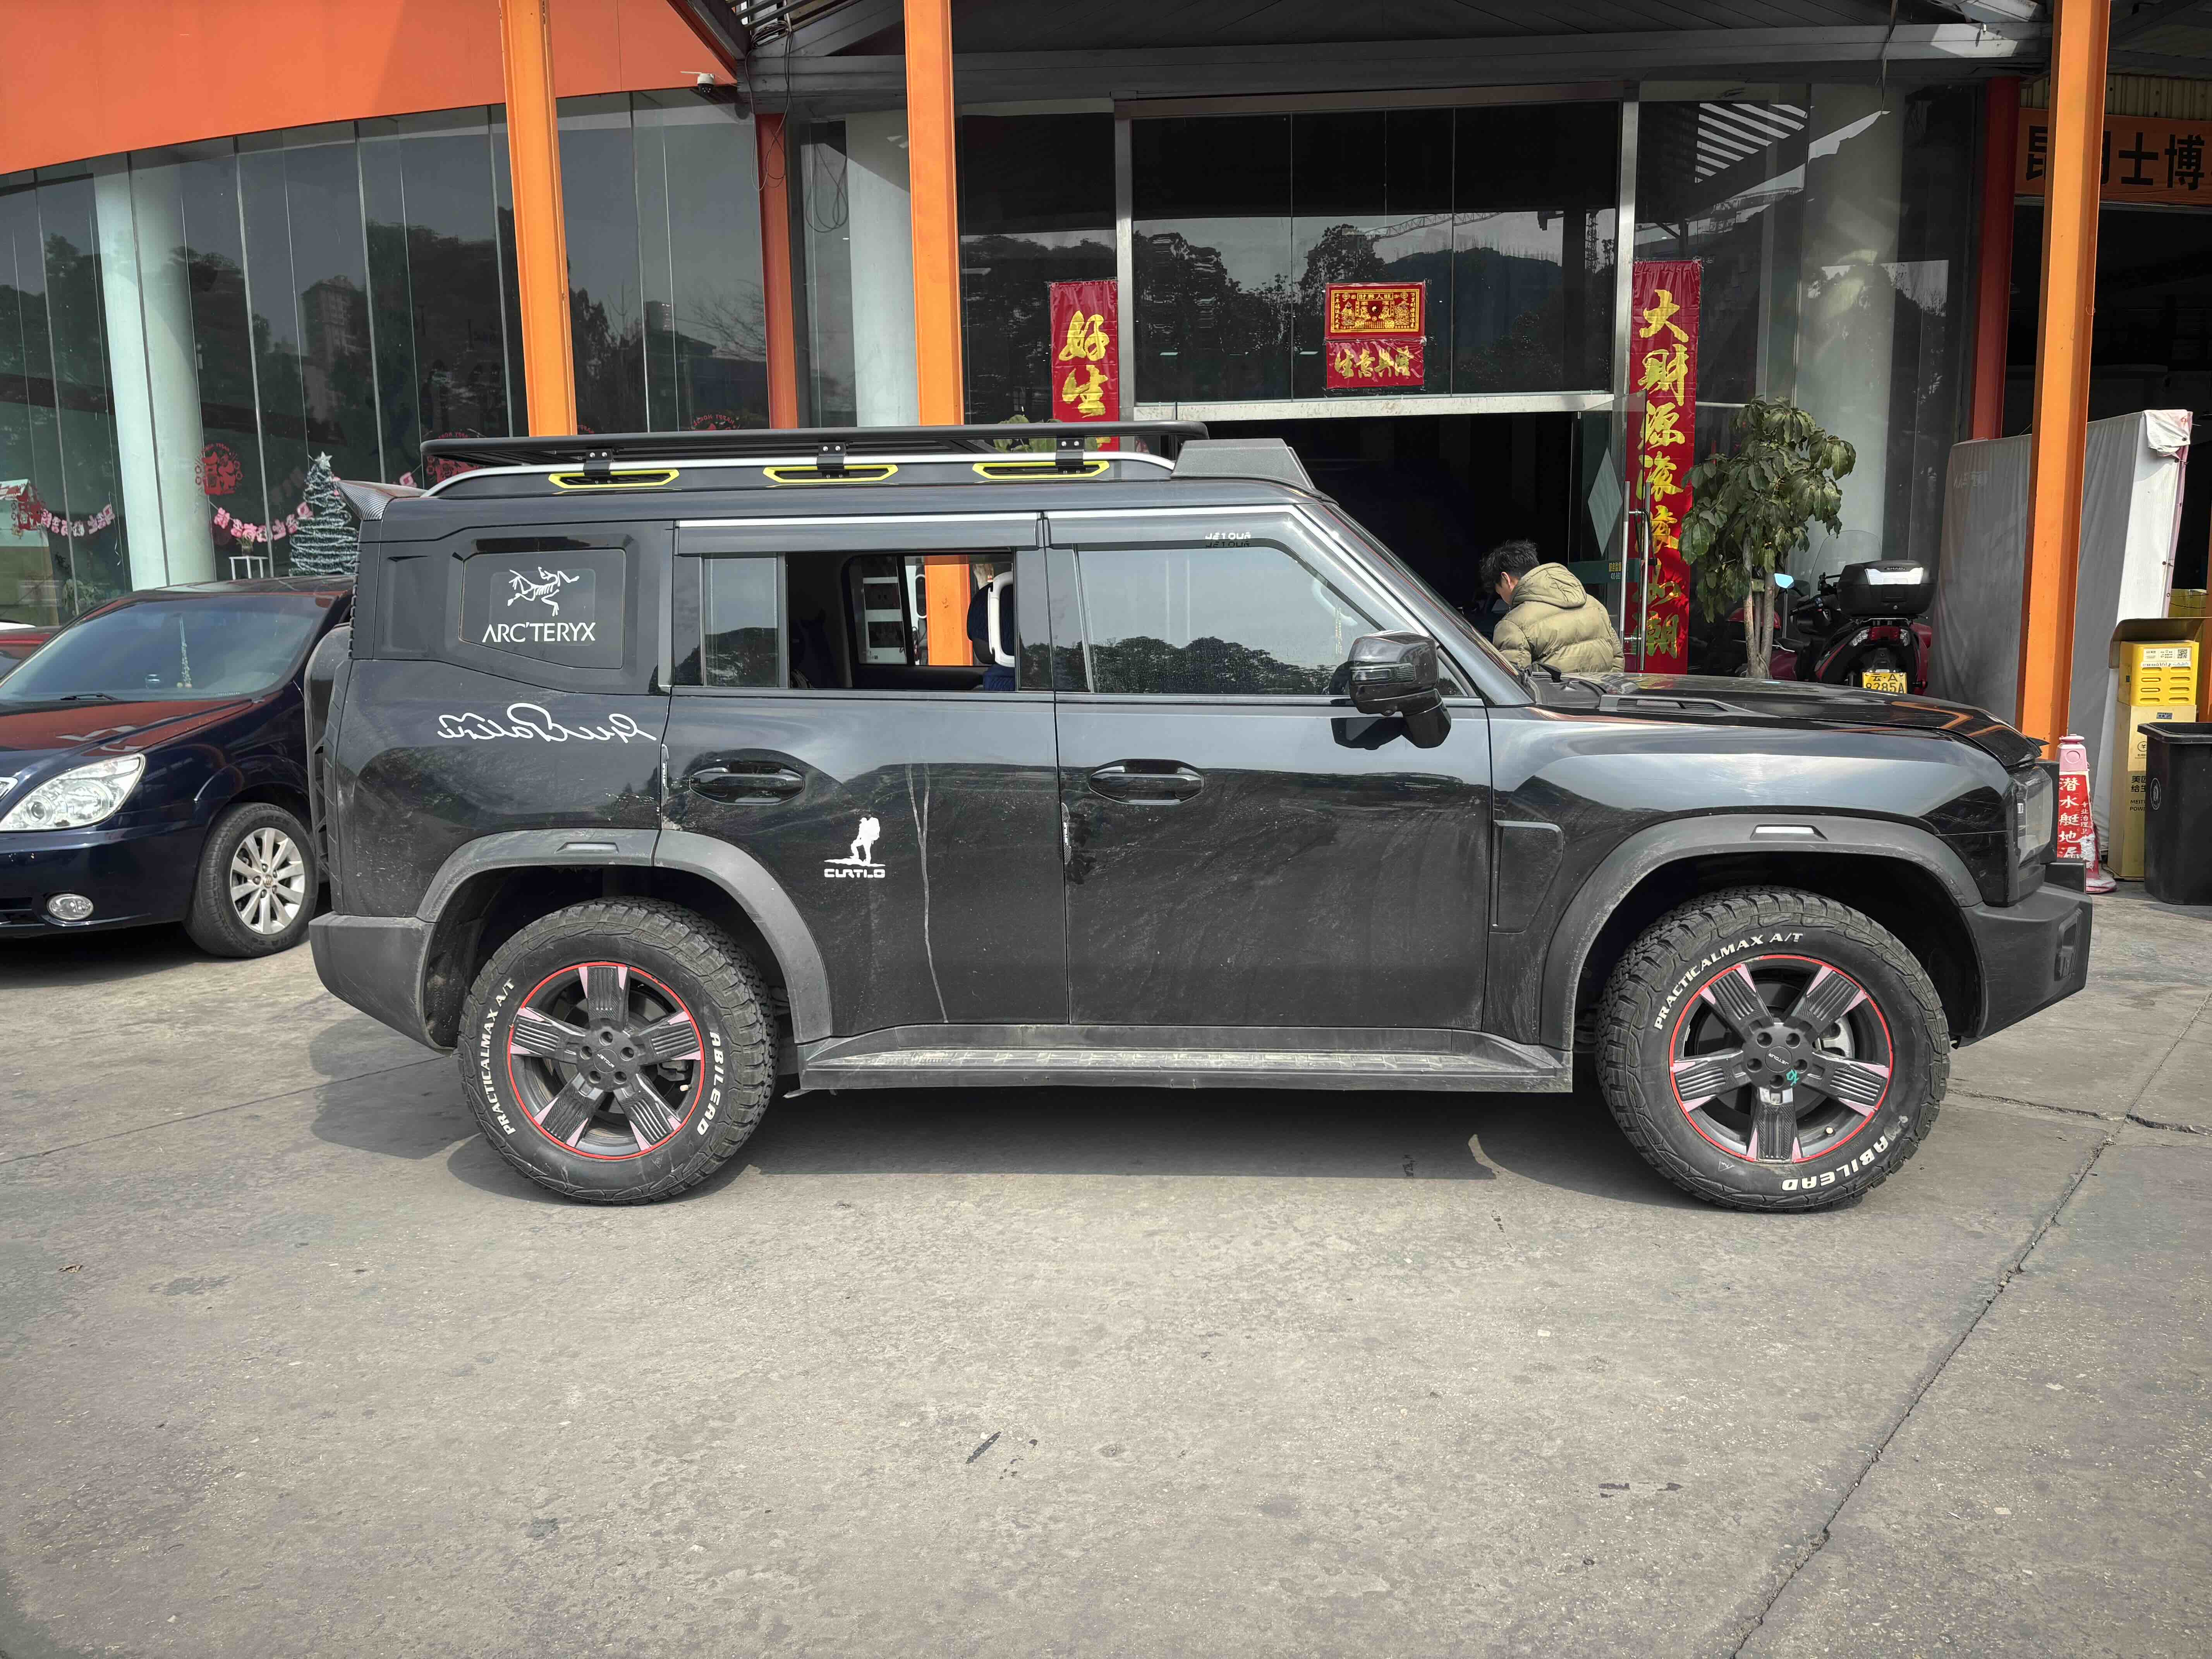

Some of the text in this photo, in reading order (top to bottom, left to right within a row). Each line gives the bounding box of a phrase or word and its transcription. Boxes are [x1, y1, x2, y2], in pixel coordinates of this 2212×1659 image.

[2026, 125, 2205, 191] 昆士博
[482, 622, 596, 643] ARC'TERYX
[824, 868, 885, 878] CURTLO
[1654, 933, 1803, 1030] PRACTICALMAX A/T
[480, 978, 516, 1135] PRACTICALMAX A/T
